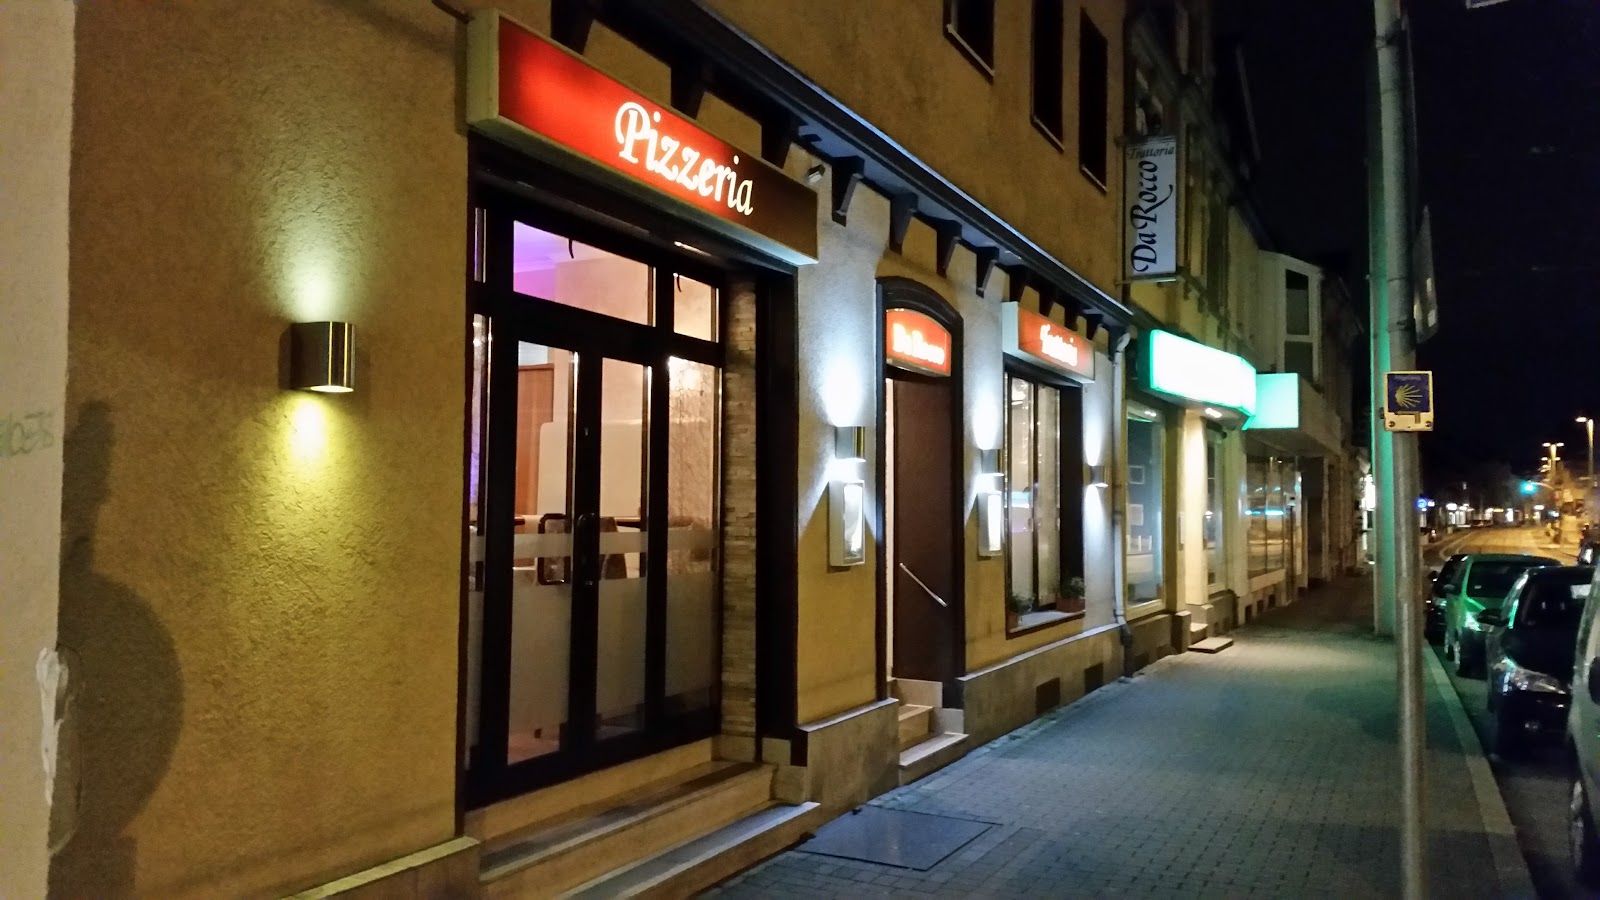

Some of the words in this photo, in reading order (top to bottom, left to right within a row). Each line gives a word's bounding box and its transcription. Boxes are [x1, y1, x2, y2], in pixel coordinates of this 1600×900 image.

[615, 101, 754, 216] Pizzeria
[1130, 160, 1174, 230] Rocco
[1130, 232, 1158, 273] Da
